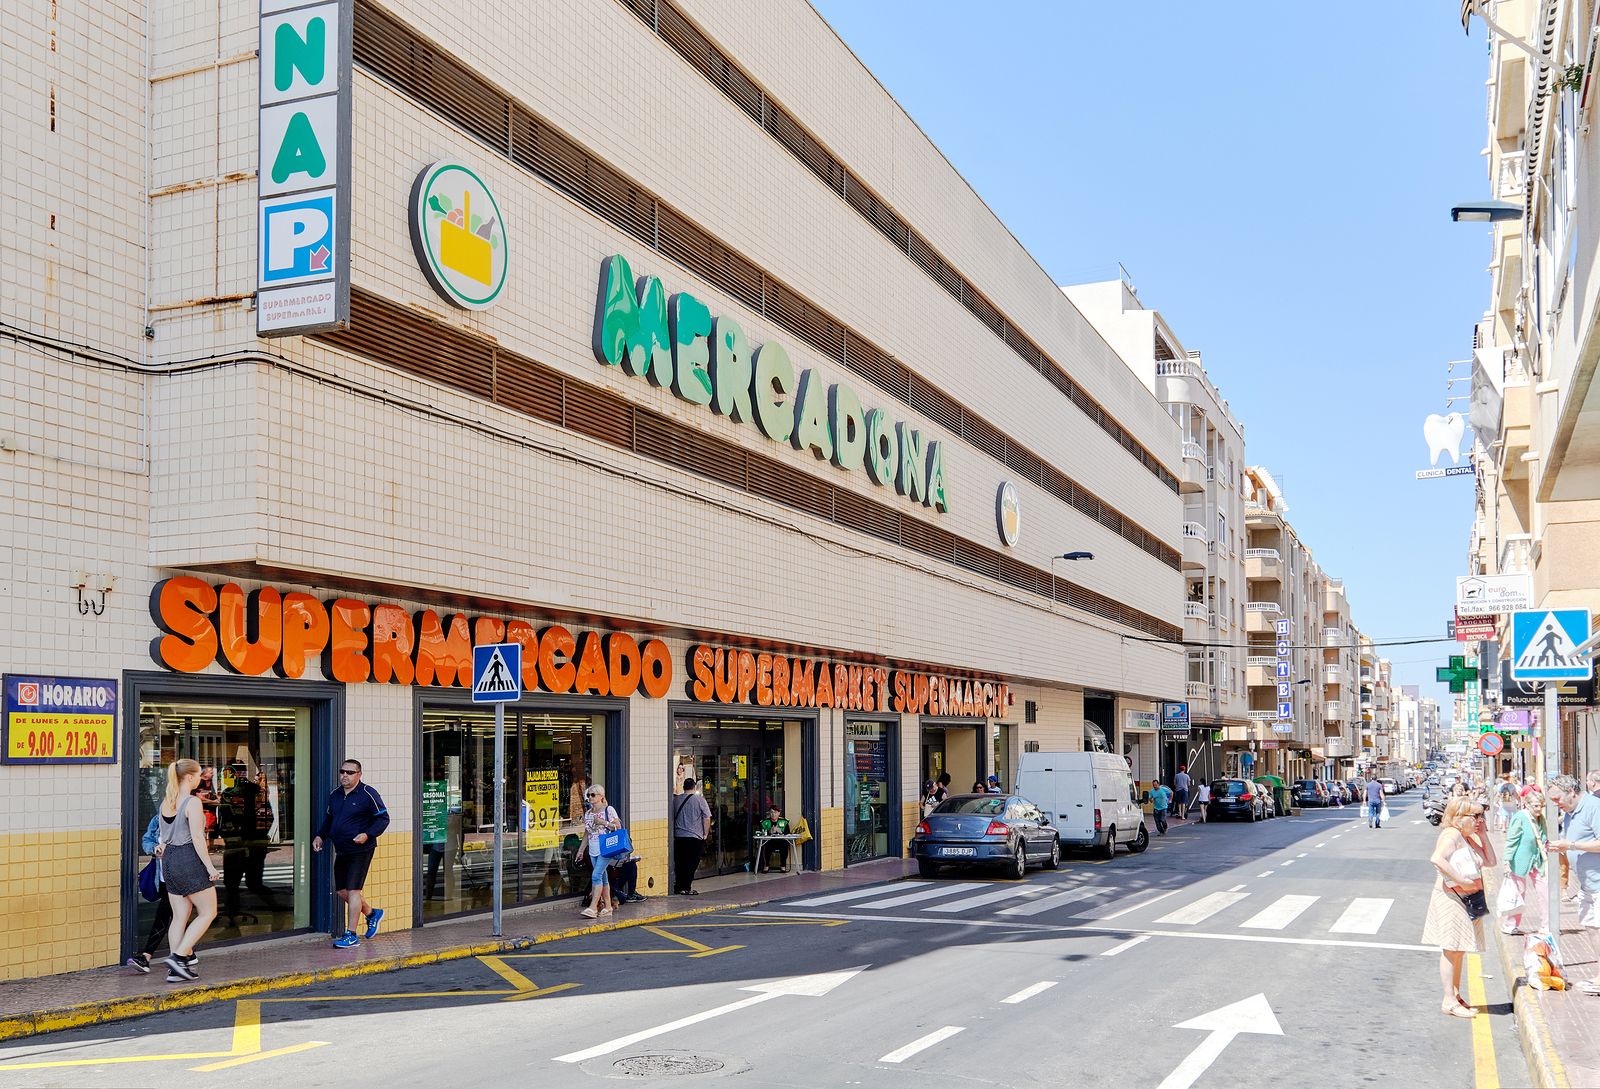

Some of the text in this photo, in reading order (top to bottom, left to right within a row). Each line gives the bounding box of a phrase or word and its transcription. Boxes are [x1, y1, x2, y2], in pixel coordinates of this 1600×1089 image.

[268, 207, 328, 271] P
[593, 254, 949, 513] MERCADONA
[42, 684, 107, 707] HORARIO
[685, 644, 887, 712] SUPERMARKET
[1277, 621, 1289, 717] HOTEL
[1507, 695, 1544, 704] Peluquería
[28, 731, 55, 757] 9.00
[66, 731, 98, 756] 21.30
